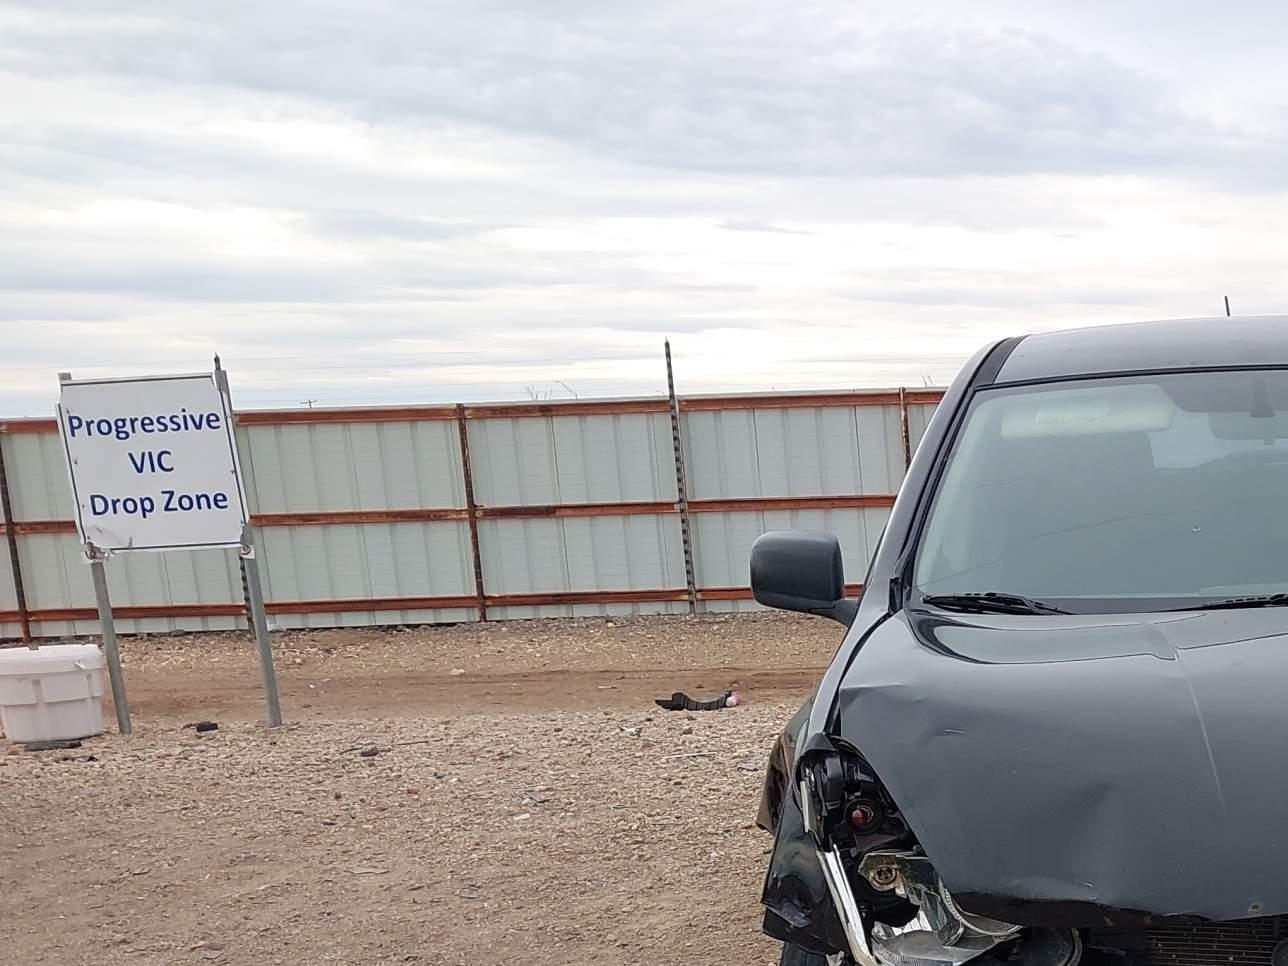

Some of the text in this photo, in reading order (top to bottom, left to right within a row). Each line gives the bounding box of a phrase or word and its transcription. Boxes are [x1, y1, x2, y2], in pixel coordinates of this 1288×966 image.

[68, 408, 220, 440] Progressive
[128, 450, 174, 474] VIC
[90, 490, 229, 518] Drop Zone
